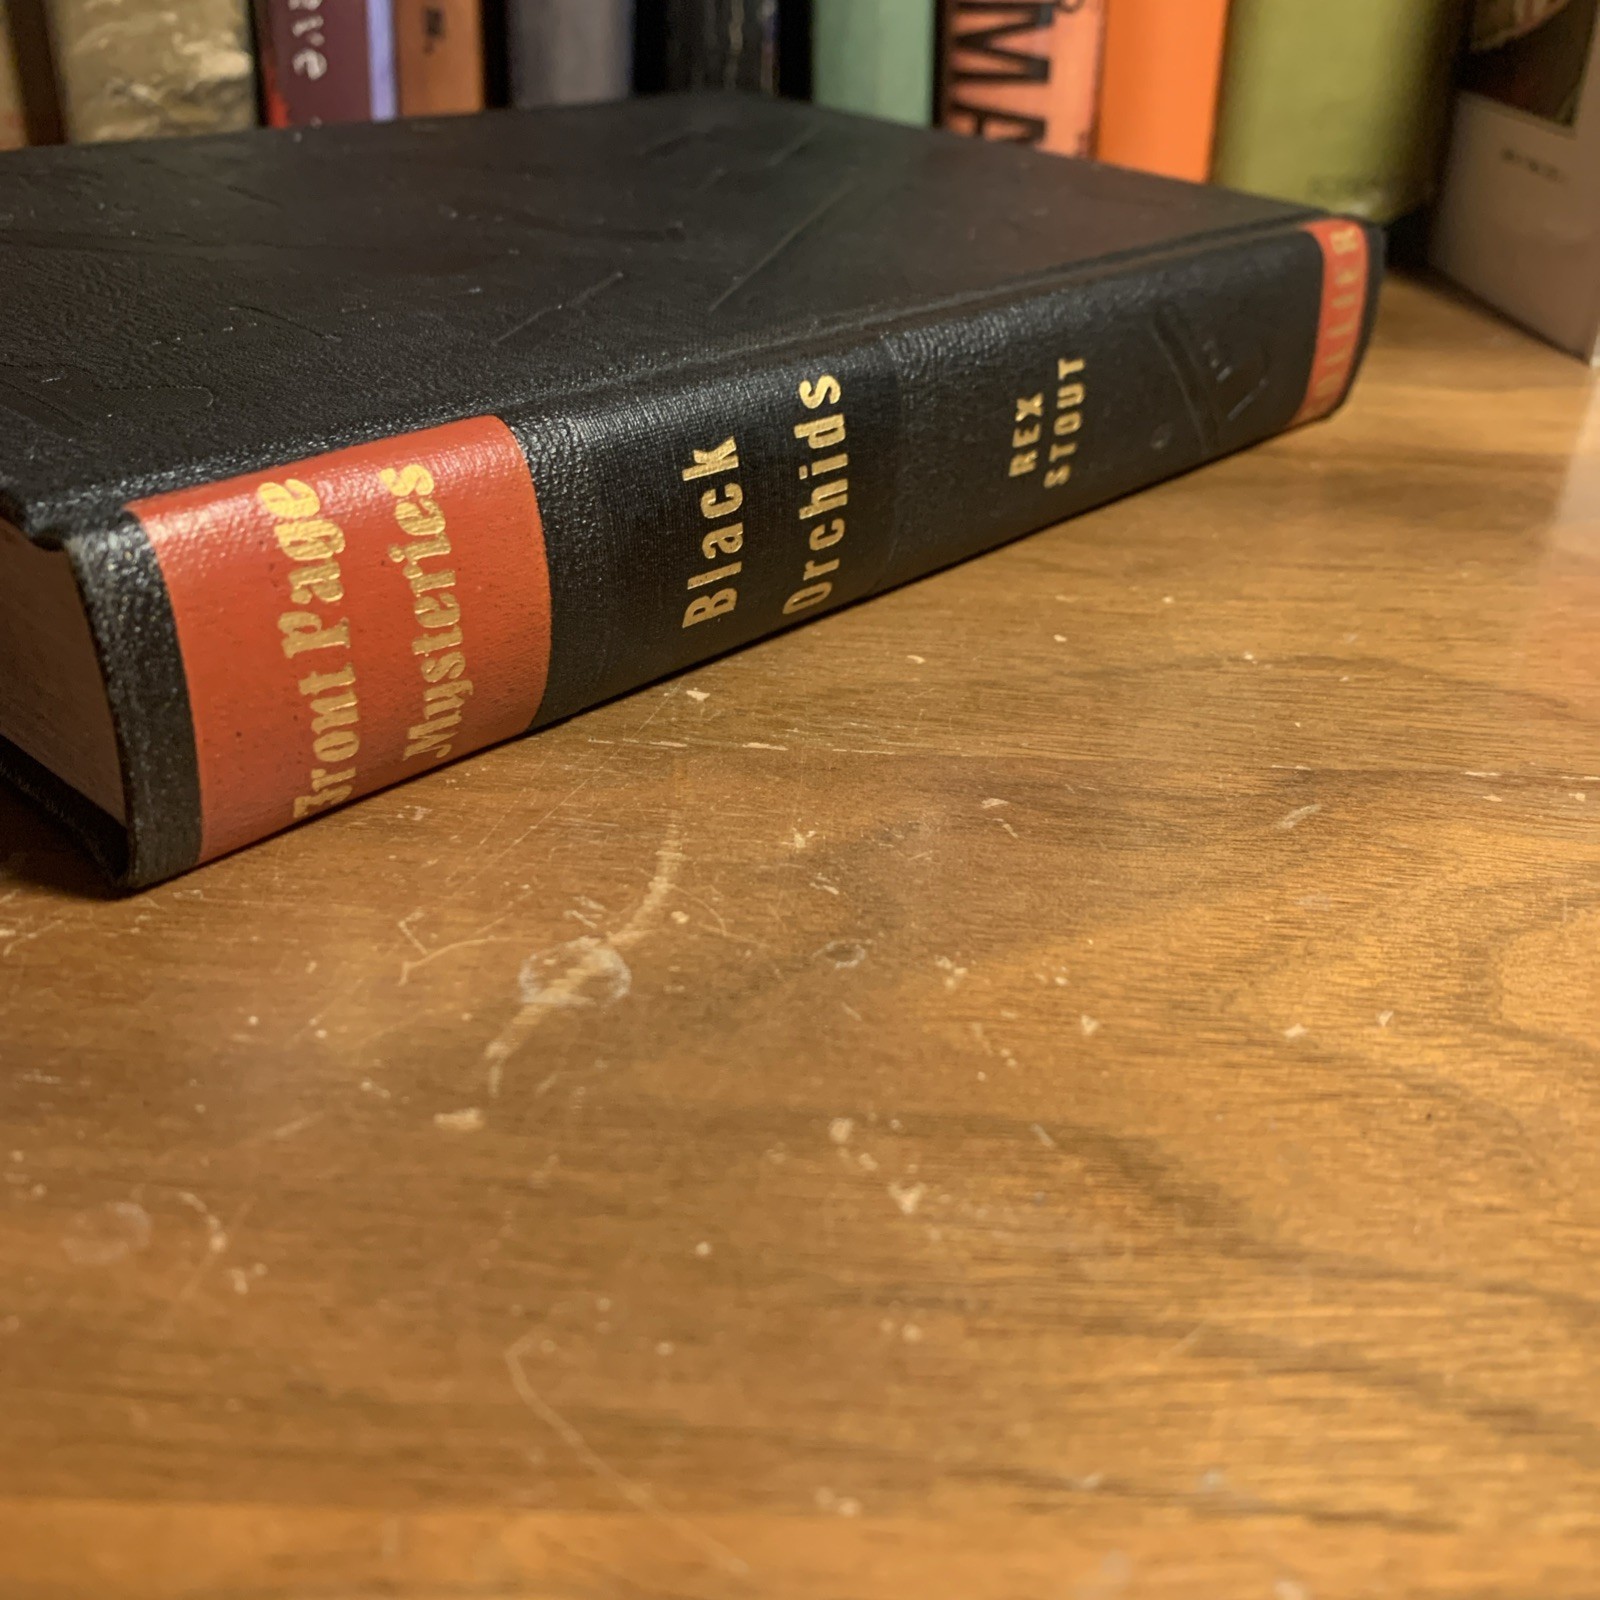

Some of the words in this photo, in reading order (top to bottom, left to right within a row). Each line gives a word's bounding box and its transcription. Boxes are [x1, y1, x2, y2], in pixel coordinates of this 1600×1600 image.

[782, 373, 849, 615] Orchids
[1008, 392, 1044, 478] REX
[1043, 357, 1086, 489] STOUT
[256, 478, 351, 660] Page
[379, 464, 474, 761] Mysteries
[681, 435, 744, 628] Black
[293, 662, 360, 819] Front
